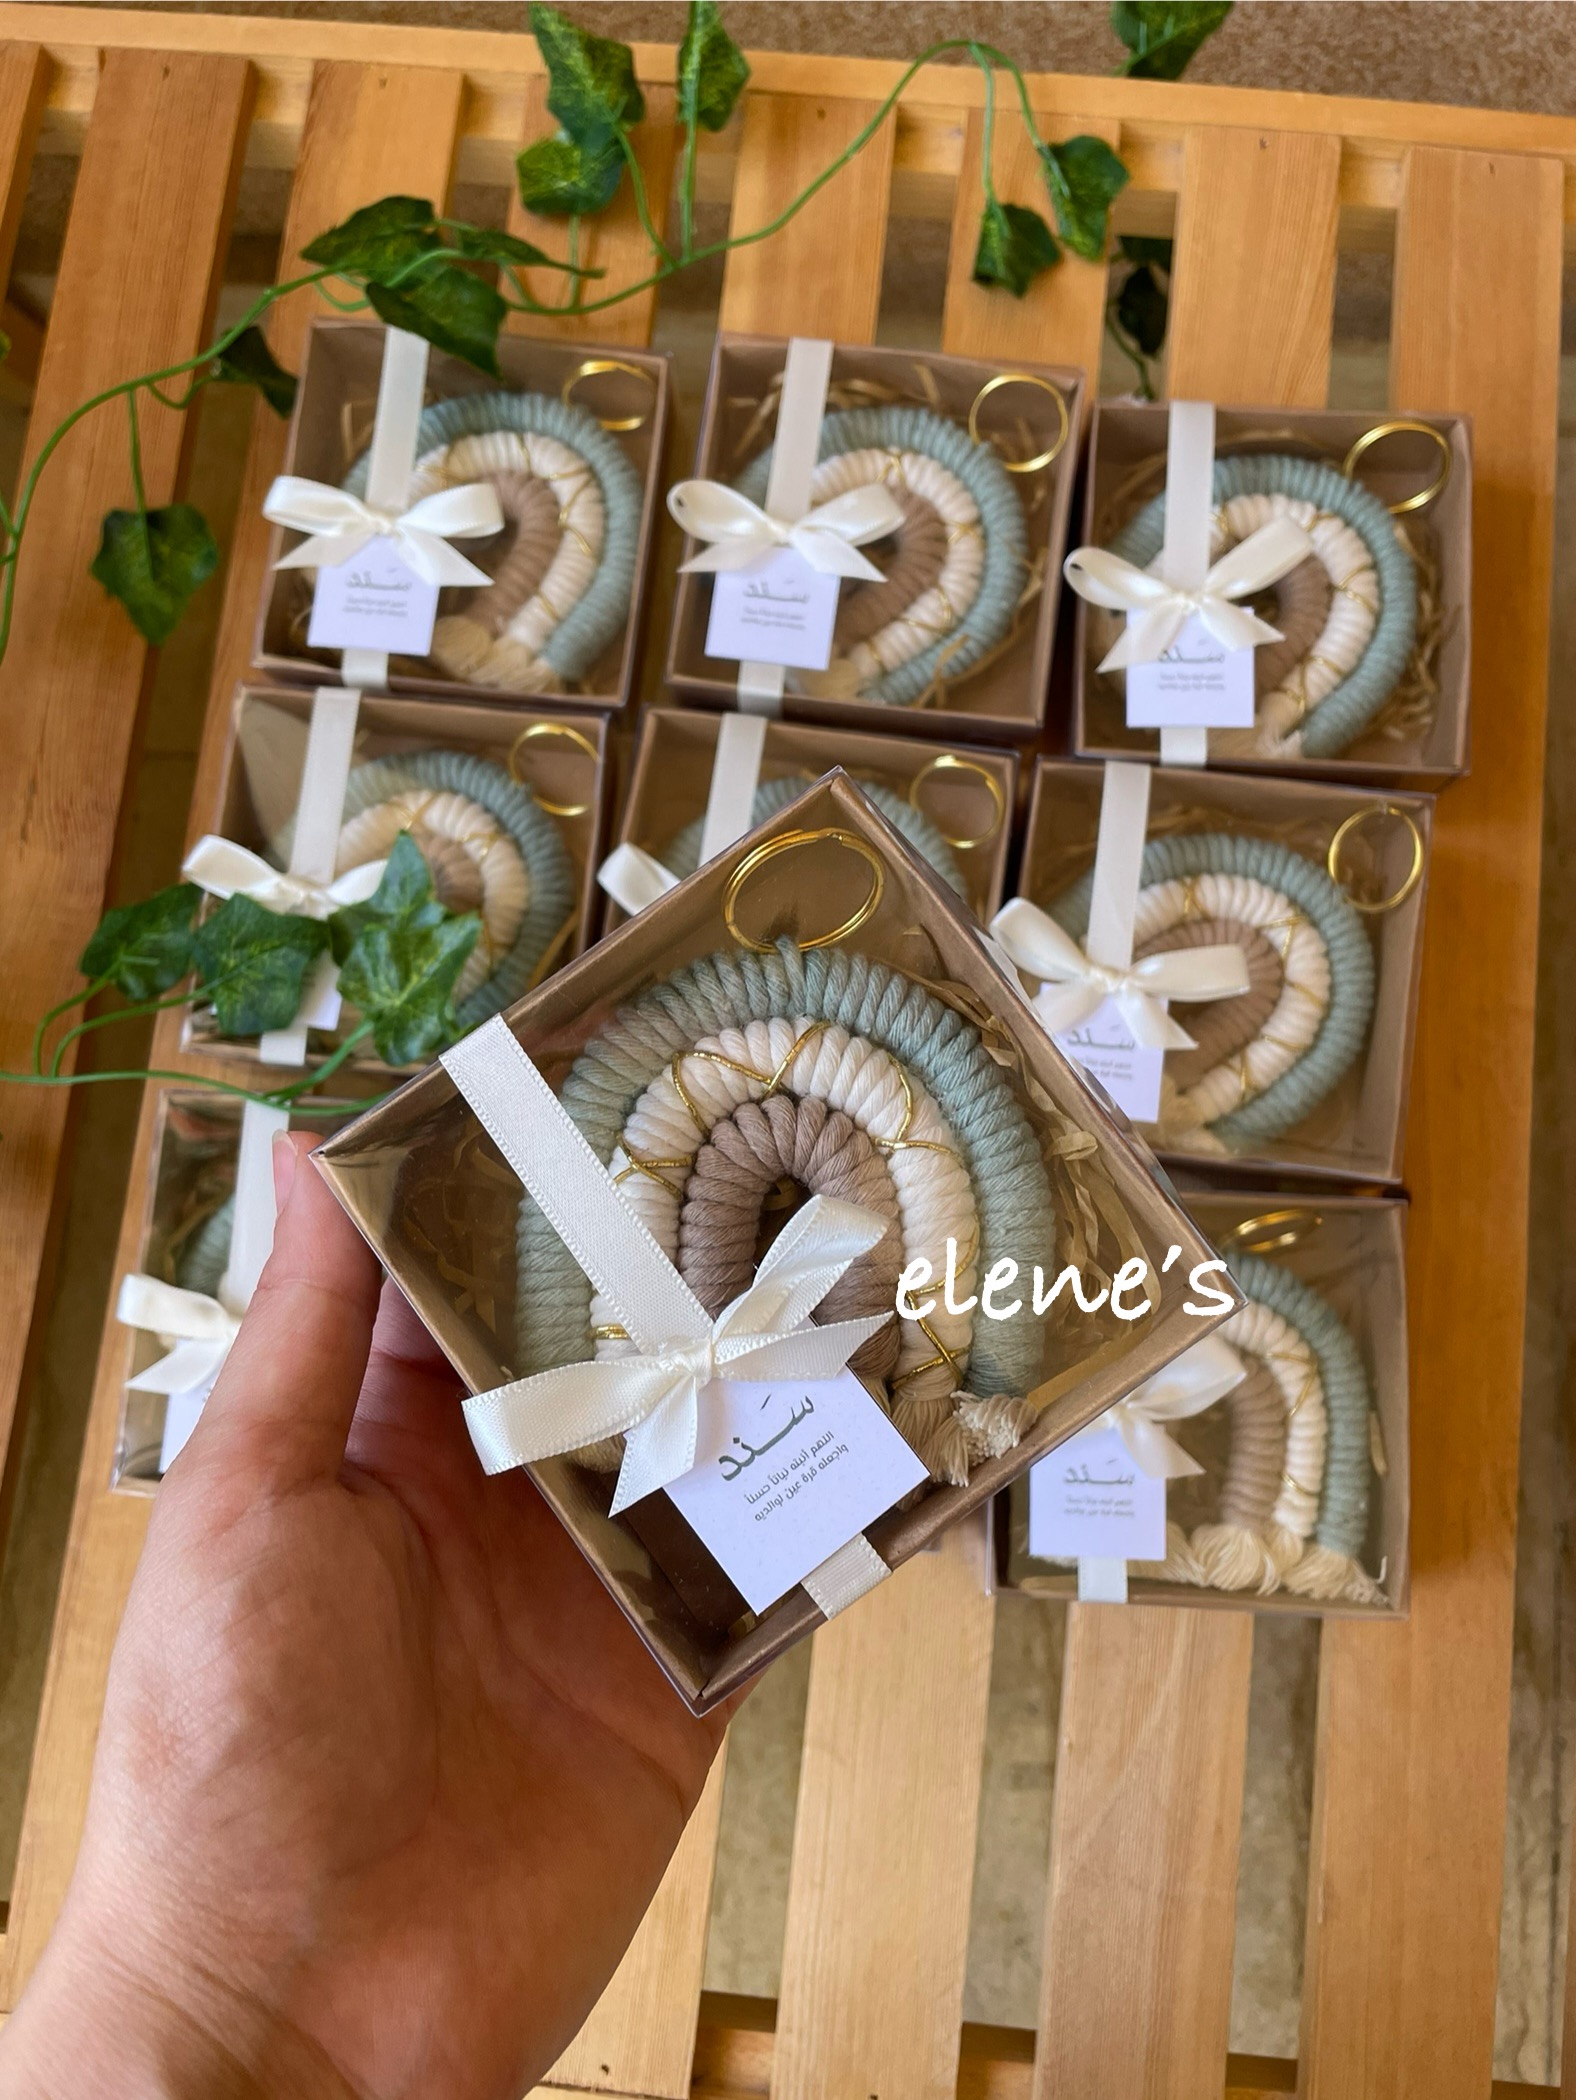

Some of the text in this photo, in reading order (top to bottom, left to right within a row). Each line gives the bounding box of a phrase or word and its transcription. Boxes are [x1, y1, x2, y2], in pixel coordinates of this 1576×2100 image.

[810, 1430, 835, 1457] اللهم
[754, 1444, 849, 1521] واجعله قرة عين لوالديه
